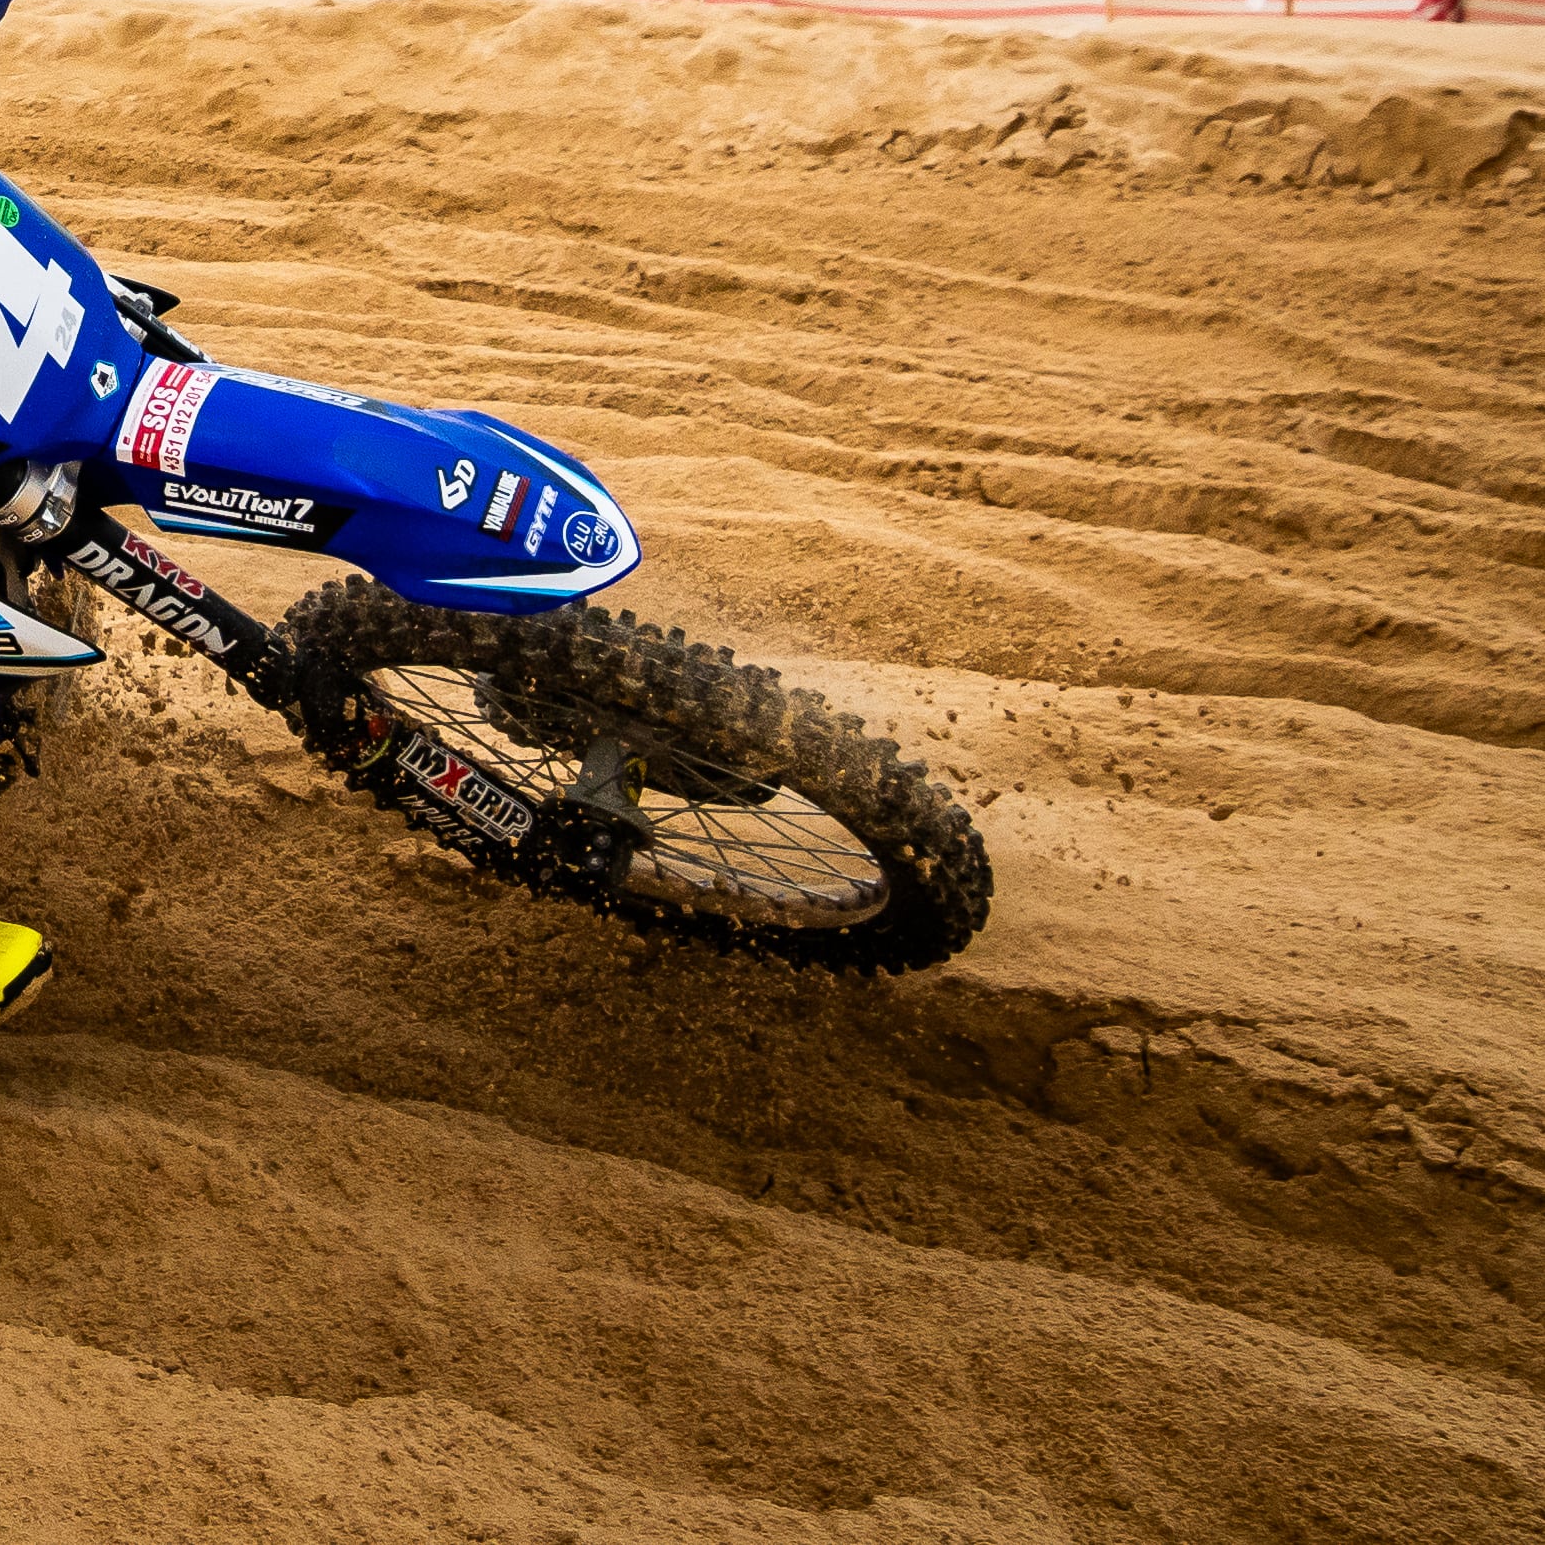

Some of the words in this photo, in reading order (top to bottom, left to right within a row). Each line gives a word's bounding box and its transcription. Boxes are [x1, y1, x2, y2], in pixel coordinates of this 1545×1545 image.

[55, 307, 78, 351] 24
[142, 386, 179, 431] SOS
[182, 386, 205, 407] 201
[172, 409, 193, 435] 912
[163, 439, 184, 471] +351
[438, 460, 476, 510] 6D
[482, 470, 521, 532] YAMALUBE
[244, 513, 315, 533] LIMOGES
[293, 498, 315, 521] 7
[524, 484, 559, 557] GYTR
[121, 531, 206, 600] KYB
[67, 540, 238, 654] DRAGON
